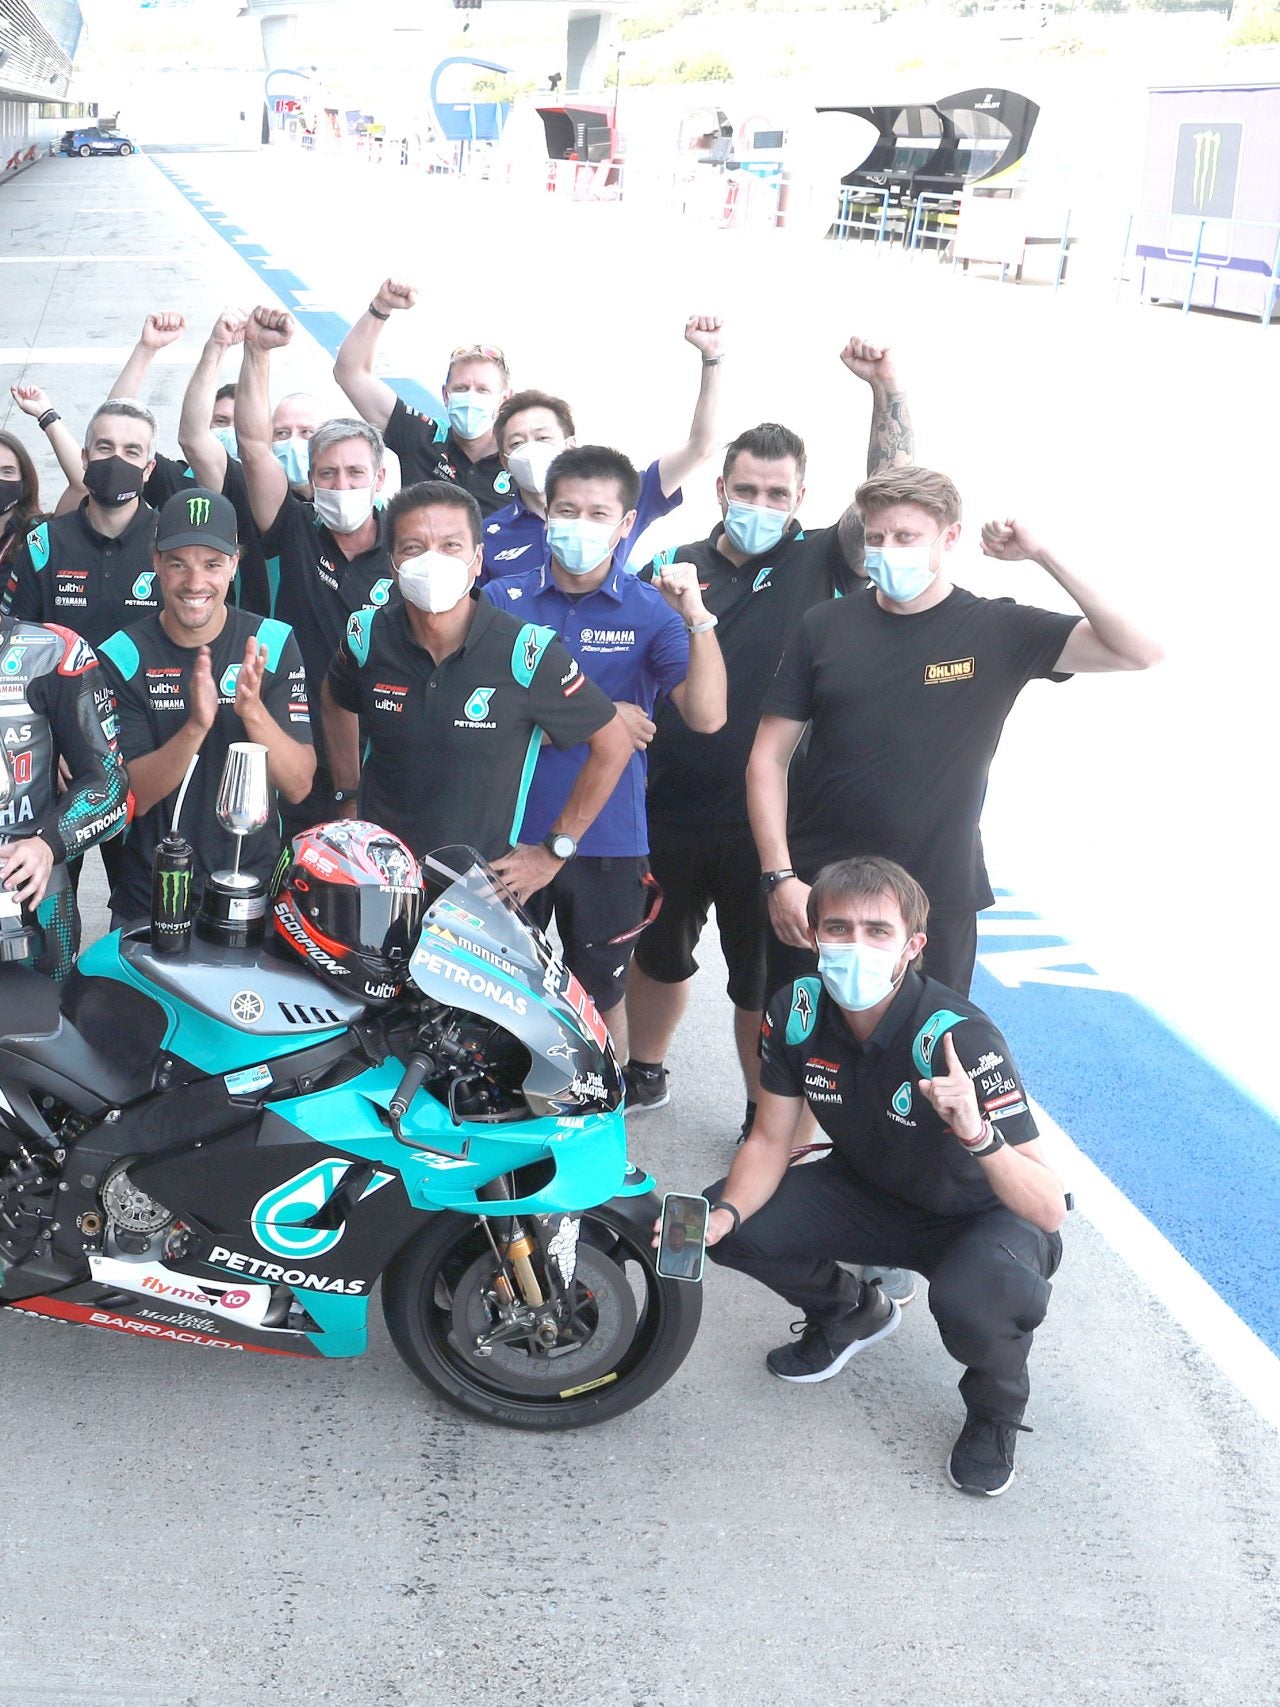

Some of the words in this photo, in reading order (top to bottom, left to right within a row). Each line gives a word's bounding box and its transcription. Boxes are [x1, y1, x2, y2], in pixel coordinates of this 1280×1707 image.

[124, 599, 158, 607] PETRONAS
[594, 630, 636, 642] YAMAHA
[928, 660, 972, 679] ÖHLINS
[149, 683, 180, 694] withu
[153, 698, 185, 709] YAMAHA
[375, 699, 404, 713] withu
[453, 719, 497, 729] PETRONAS
[75, 801, 128, 843] PETRONAS
[379, 886, 418, 895] PETRONAS
[273, 902, 345, 974] SCORPION
[413, 948, 529, 1016] PETRONAS
[805, 1074, 837, 1090] withu
[807, 1090, 843, 1104] YAMAHA
[556, 1116, 585, 1129] YAMAHA
[207, 1245, 366, 1295] PETRONAS
[224, 1292, 246, 1306] to
[89, 1312, 246, 1351] BARRACUDA
